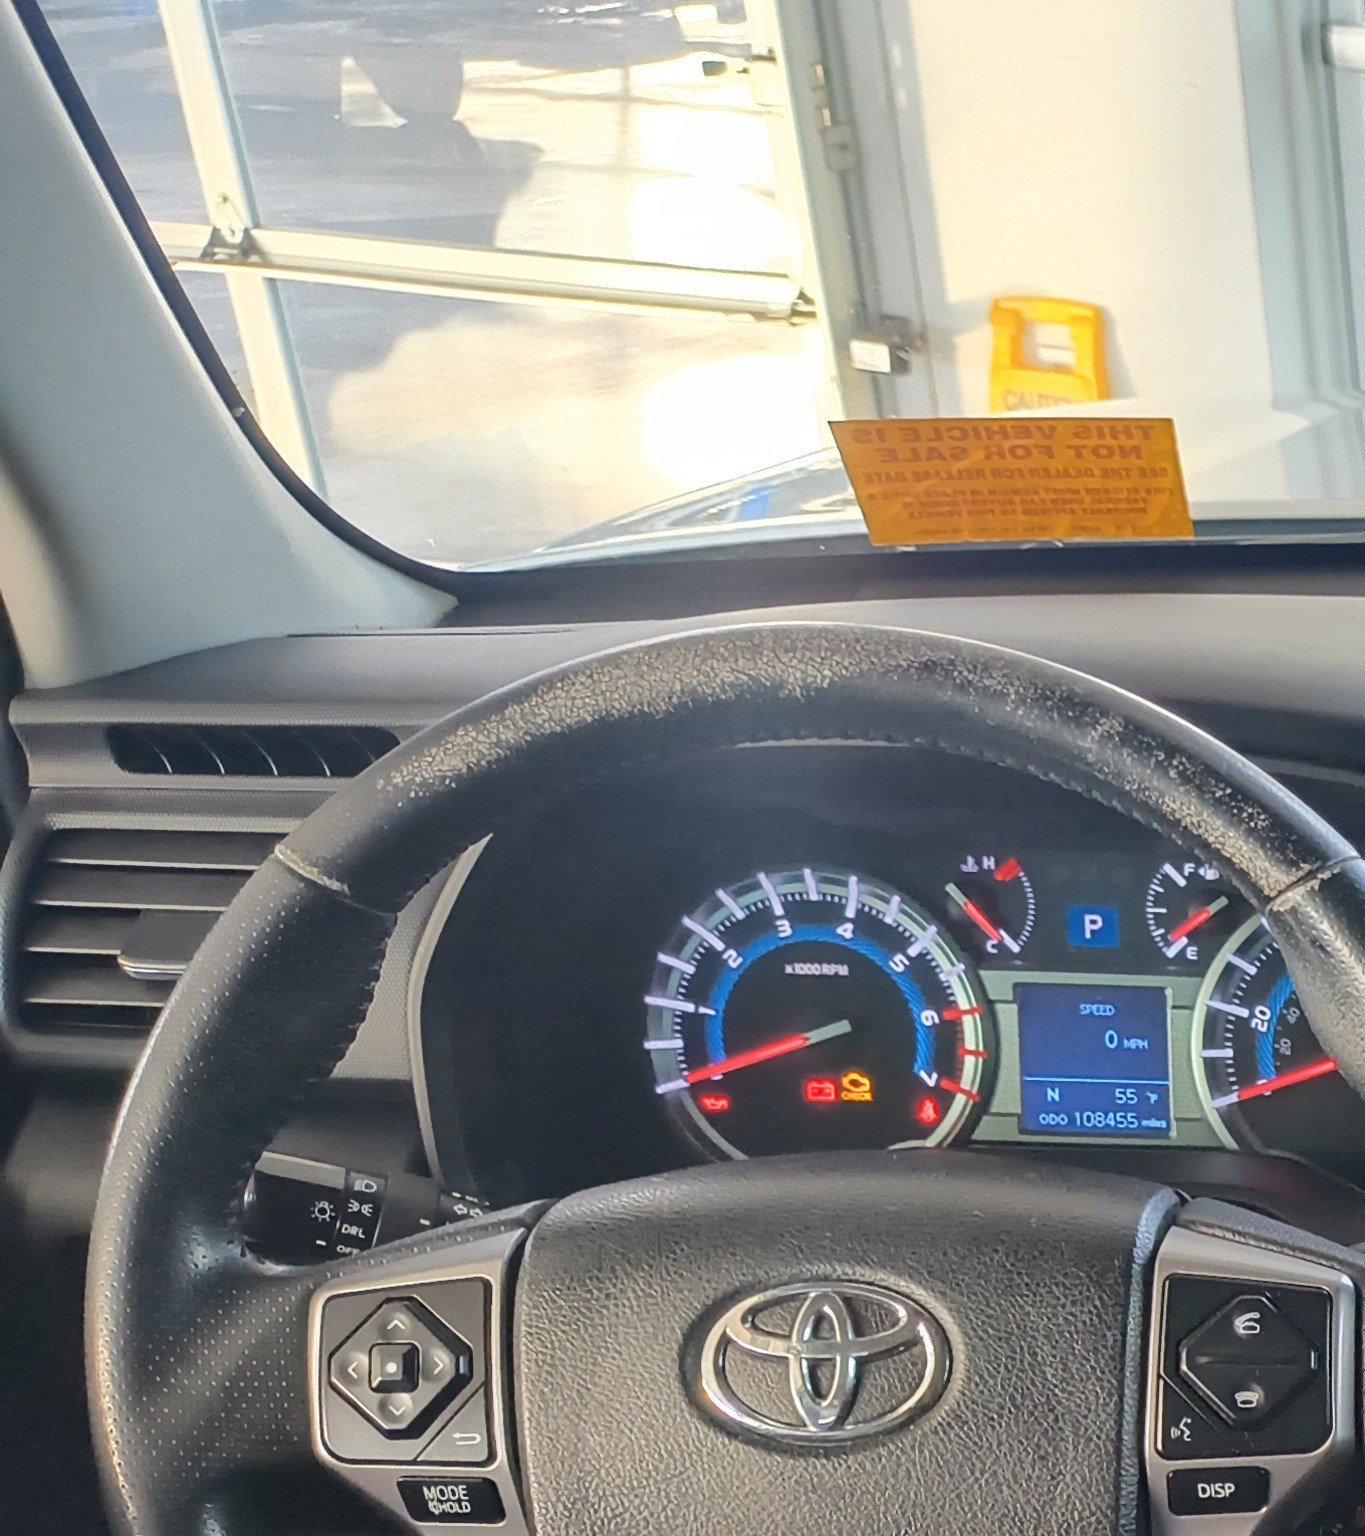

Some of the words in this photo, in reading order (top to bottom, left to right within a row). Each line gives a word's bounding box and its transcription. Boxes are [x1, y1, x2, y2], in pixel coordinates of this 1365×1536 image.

[982, 855, 995, 870] H
[1183, 863, 1195, 876] F
[775, 919, 793, 938] 3
[836, 922, 854, 939] 4
[1084, 914, 1104, 939] P
[986, 940, 998, 953] C
[1186, 946, 1198, 960] E
[722, 949, 743, 968] 2
[889, 954, 910, 972] 5
[920, 1009, 940, 1026] 6
[1079, 1003, 1115, 1016] SPEED
[1250, 1005, 1271, 1033] 20
[1105, 1029, 1118, 1050] 0
[1123, 1038, 1148, 1049] MPH
[919, 1070, 938, 1087] 7
[1046, 1087, 1060, 1102] N
[1115, 1088, 1138, 1104] 55
[1039, 1113, 1068, 1126] ODO
[1075, 1111, 1139, 1128] 108455
[341, 1223, 365, 1239] DRL
[423, 1484, 469, 1500] MODE
[1197, 1482, 1235, 1499] DISP
[439, 1501, 471, 1514] HOLD
